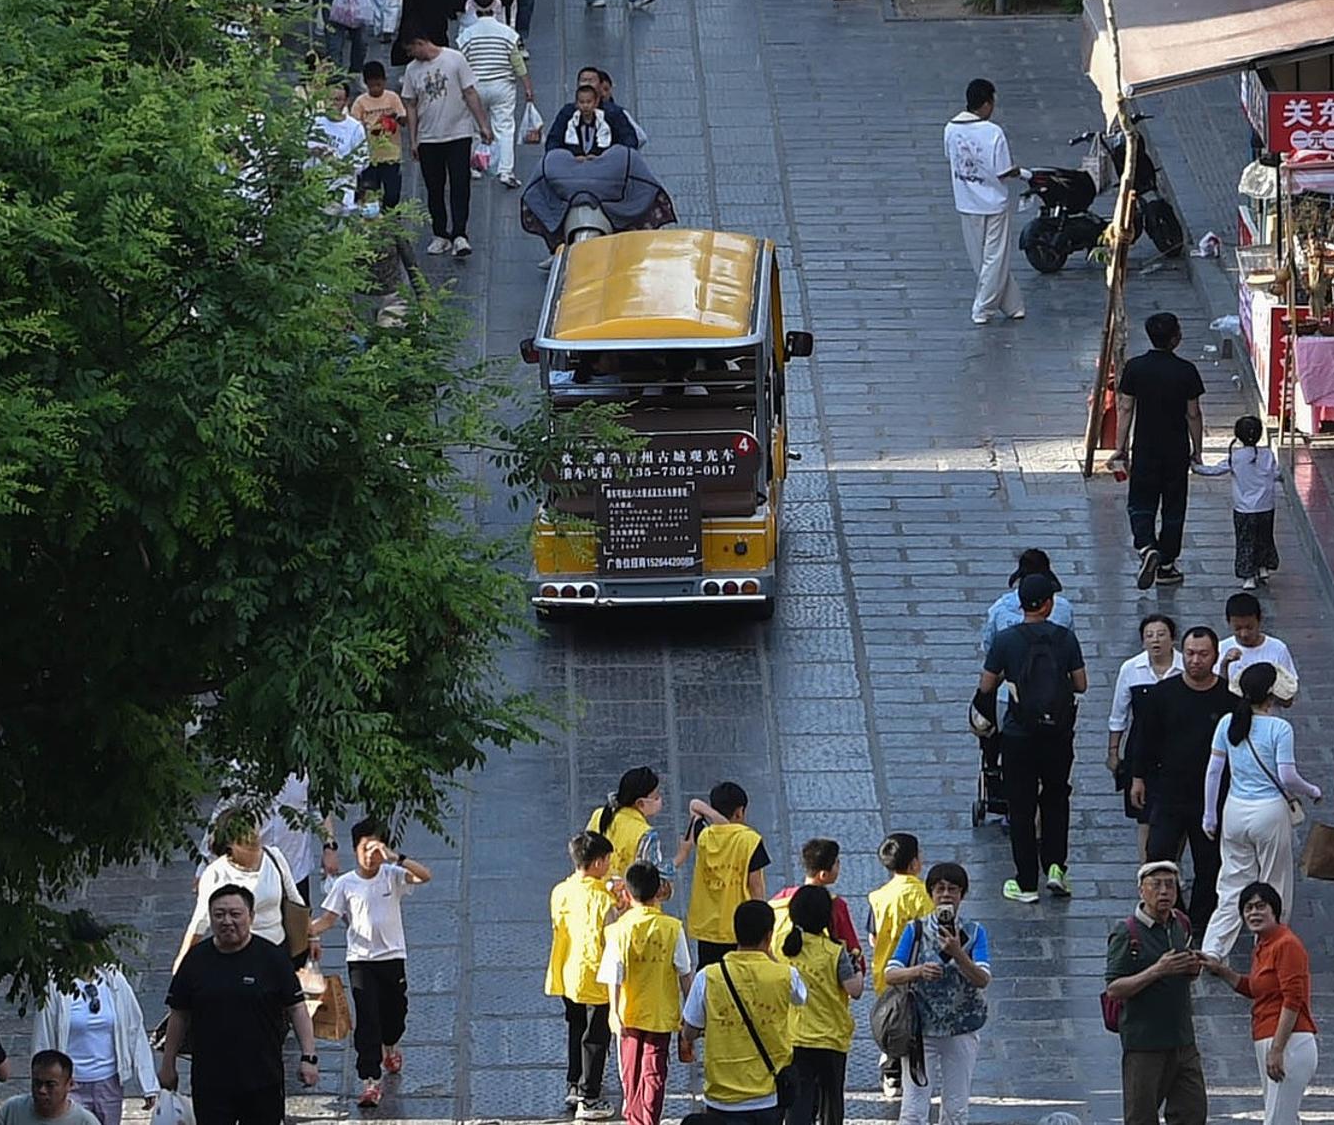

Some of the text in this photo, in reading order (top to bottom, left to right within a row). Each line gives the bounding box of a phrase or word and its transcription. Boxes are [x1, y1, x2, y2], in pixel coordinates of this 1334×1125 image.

[738, 438, 749, 452] 4
[561, 449, 735, 465] 欢乘坐青州古城观光车
